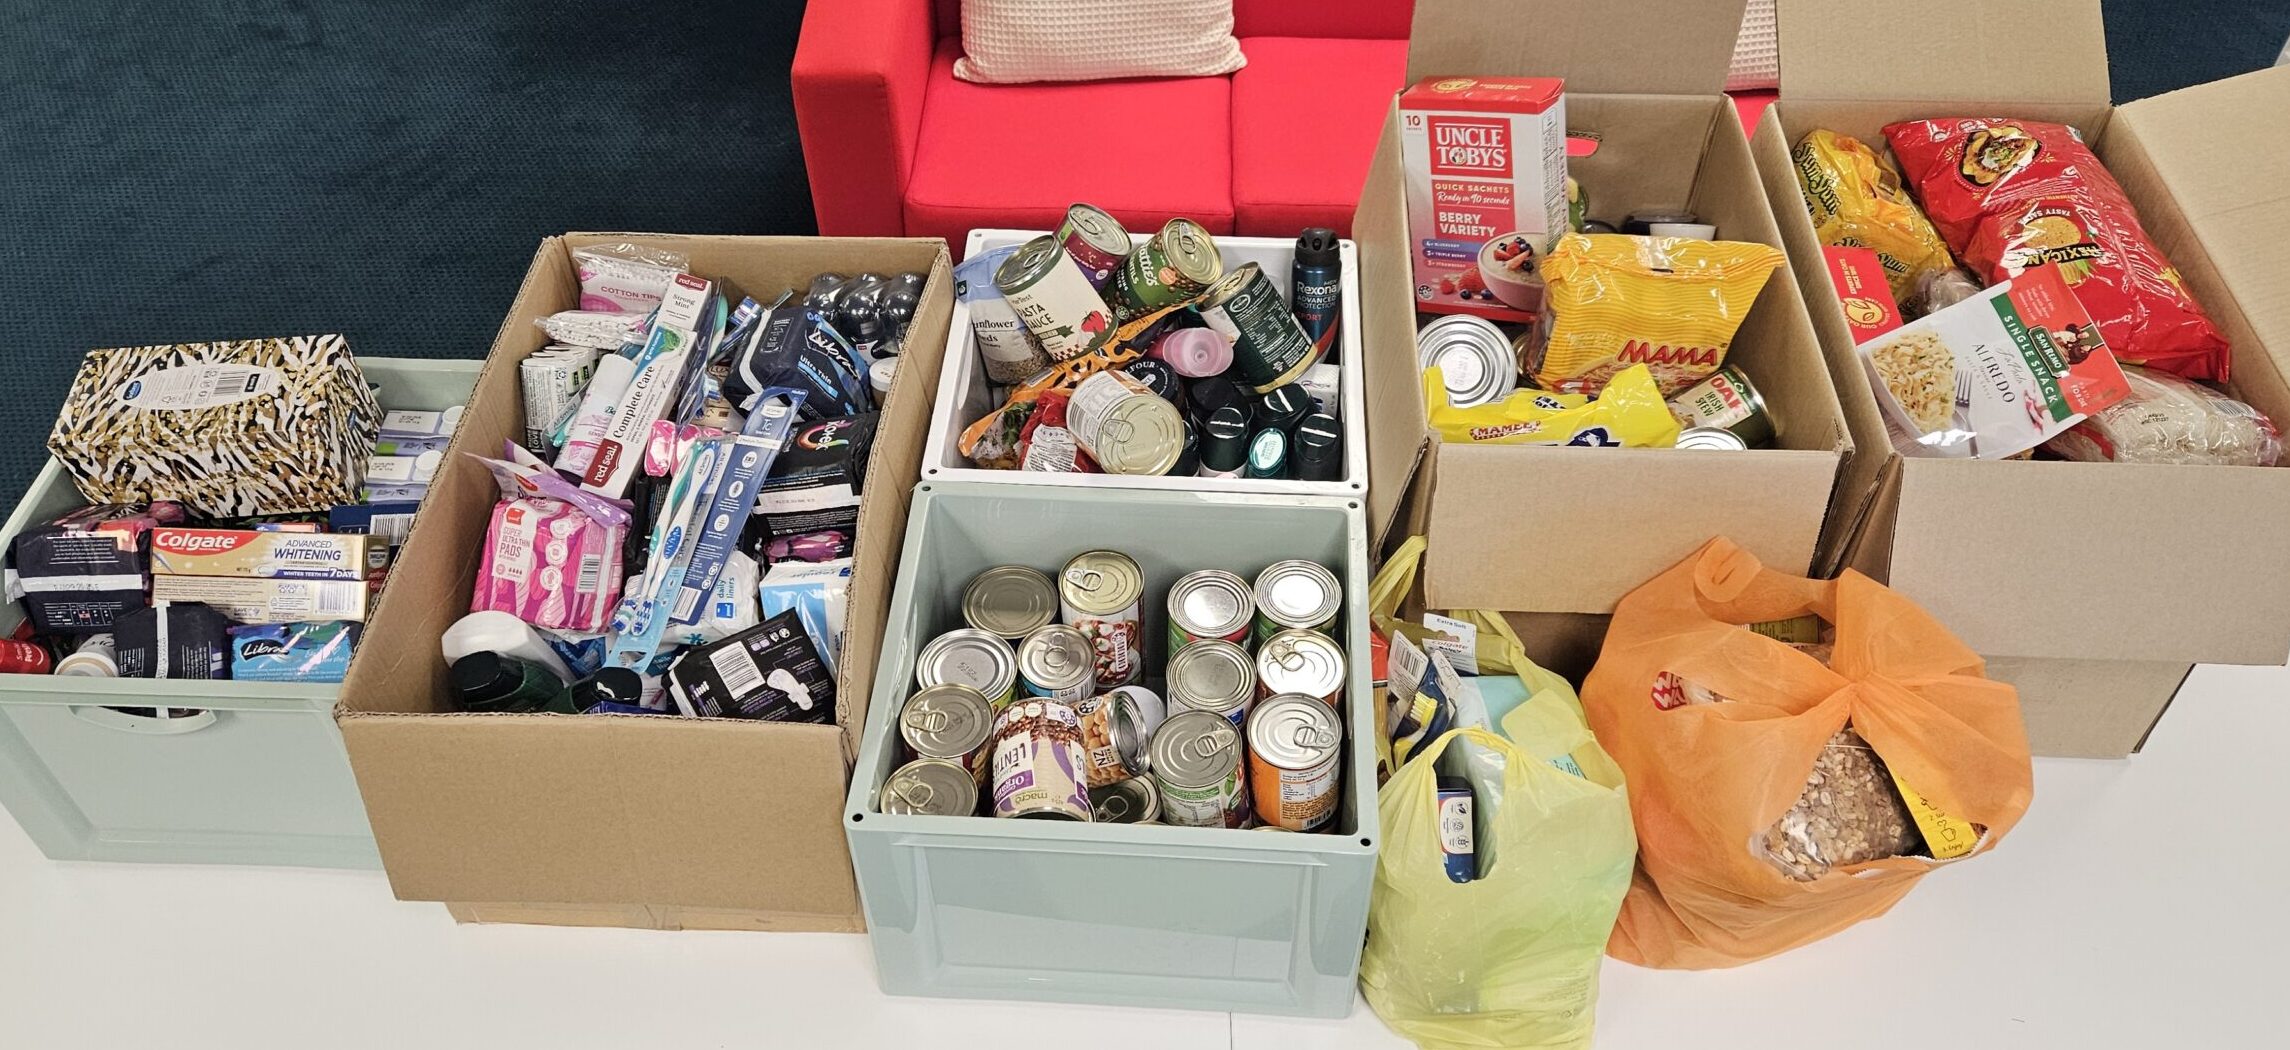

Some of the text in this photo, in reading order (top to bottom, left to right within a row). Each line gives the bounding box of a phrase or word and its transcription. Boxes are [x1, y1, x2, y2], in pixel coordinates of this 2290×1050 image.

[1406, 115, 1421, 126] 10
[1436, 127, 1505, 147] UNCLE
[1436, 146, 1506, 167] TOBYS
[1435, 183, 1509, 193] QUICK SACHETS
[1437, 192, 1461, 204] Ready
[1482, 196, 1510, 205] seconds
[1439, 212, 1481, 224] BERRY
[2046, 208, 2071, 217] TASTY
[1439, 223, 1496, 237] VARIETY
[1140, 245, 1159, 287] attie's
[600, 286, 639, 298] COTTON
[1297, 281, 1337, 295] Rexona
[675, 300, 690, 309] Mint
[1298, 296, 1337, 304] ADVANCED
[972, 320, 1015, 329] unflower
[809, 331, 859, 379] Libra
[1617, 339, 1718, 366] MAMA
[2036, 333, 2062, 369] SAN REMO
[2004, 315, 2057, 403] SINGLE SNACK
[800, 355, 832, 385] Ultra Thin
[1972, 344, 2016, 403] ALFREDO
[613, 391, 641, 439] Complete
[638, 366, 655, 390] Care
[1696, 398, 1713, 417] STEW
[1705, 391, 1724, 412] IRISH
[594, 445, 618, 482] red seal.
[503, 527, 523, 536] SUPER
[155, 531, 237, 551] Colgate
[286, 540, 332, 549] ADVANCED
[502, 535, 531, 548] ULTRA THIN
[274, 548, 341, 560] WHITENING
[500, 543, 522, 558] PADS
[718, 579, 726, 598] daily
[727, 577, 735, 599] liners
[1437, 617, 1467, 629] Extra Soft
[243, 643, 284, 656] Libra
[1093, 751, 1106, 767] NZ
[1015, 791, 1048, 804] macro
